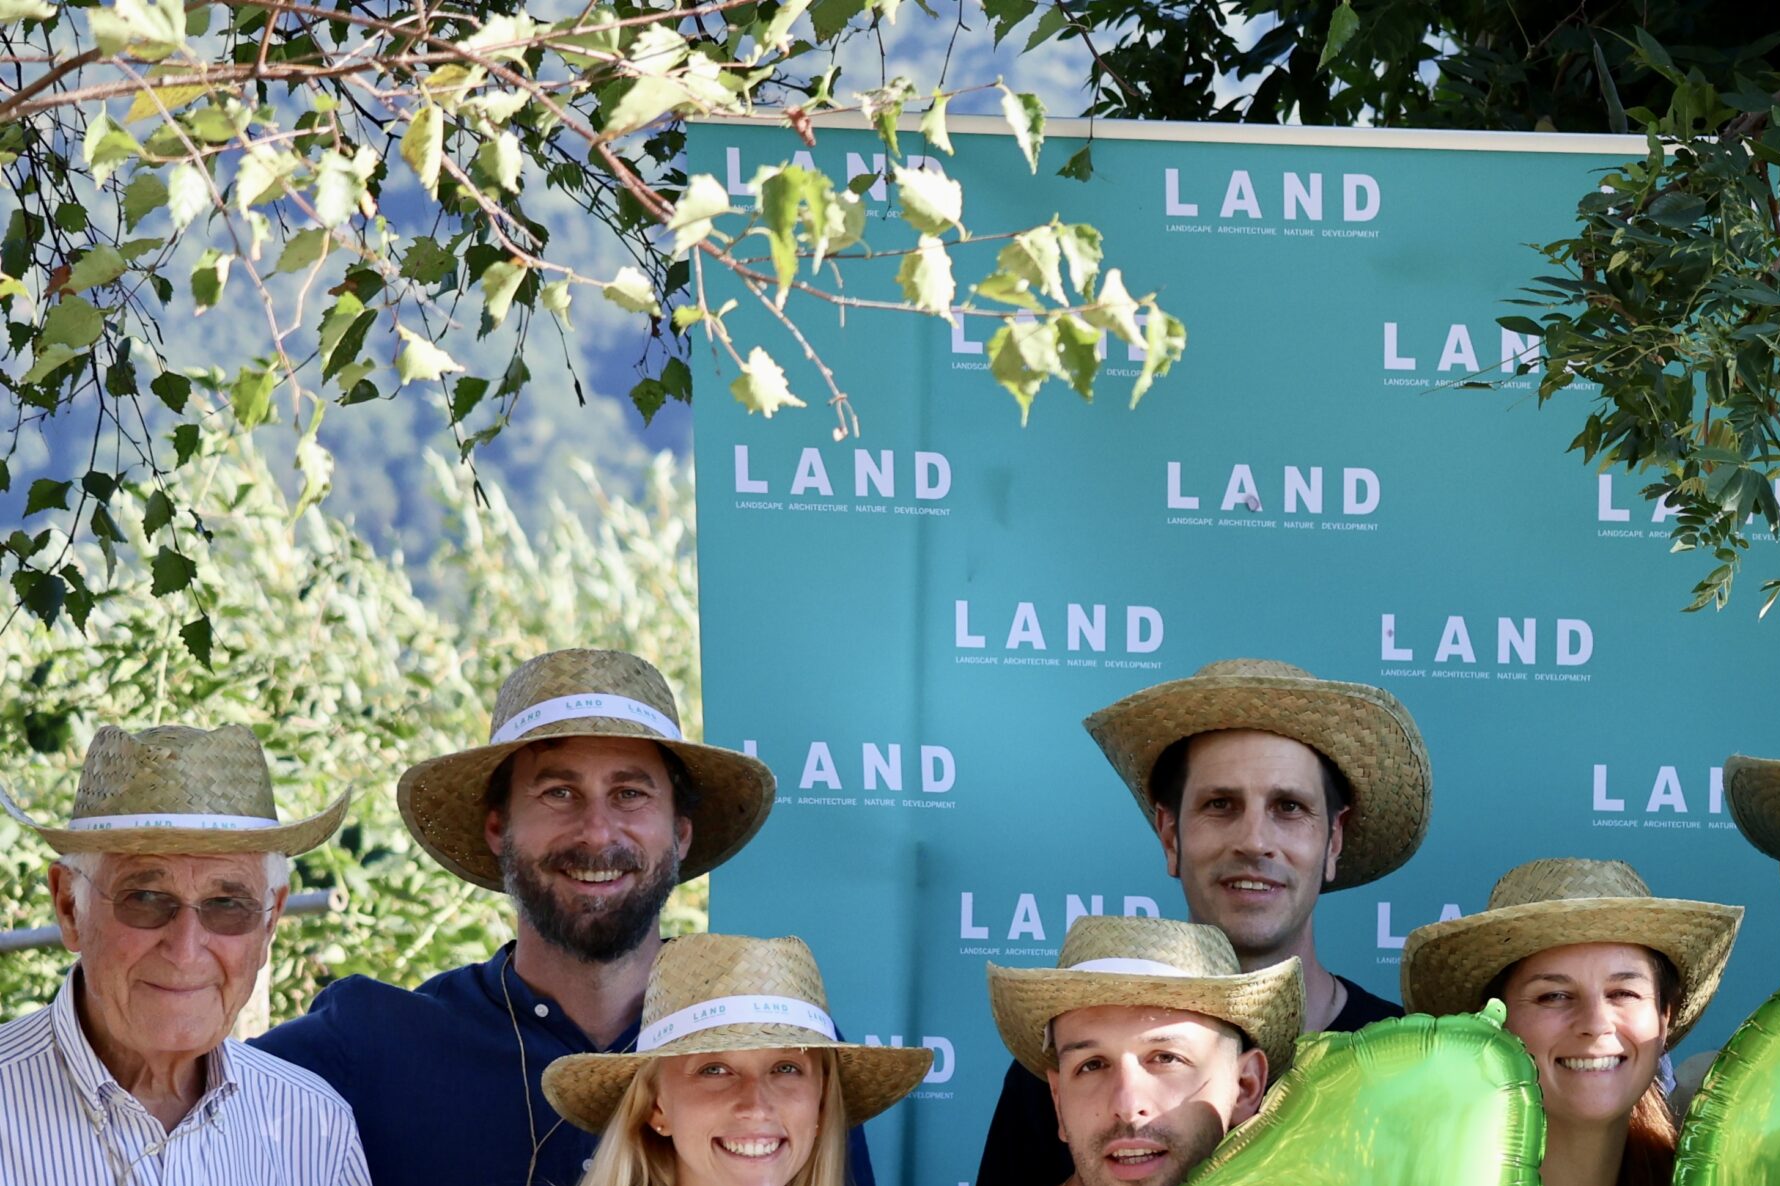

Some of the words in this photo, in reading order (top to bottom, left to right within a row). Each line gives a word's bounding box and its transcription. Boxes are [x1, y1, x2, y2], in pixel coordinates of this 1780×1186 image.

[727, 147, 943, 202] LN
[1166, 169, 1380, 221] LAND
[1218, 226, 1275, 235] ARCHITECTURE
[1384, 323, 1583, 374] LAN
[735, 445, 951, 504] LAND
[1168, 462, 1380, 515] LAND
[789, 503, 847, 512] ARCHITECTURE
[894, 507, 950, 515] DEVELOPMENT
[1218, 519, 1276, 527] ARCHITECTURE
[956, 600, 1163, 652] LAND
[1382, 614, 1593, 665] LAND
[566, 699, 603, 709] LAND
[798, 797, 856, 805] ARCHITECTURE
[903, 800, 955, 808] DEVELOPMENT
[693, 1004, 726, 1020] LAND
[754, 1003, 788, 1012] LAND
